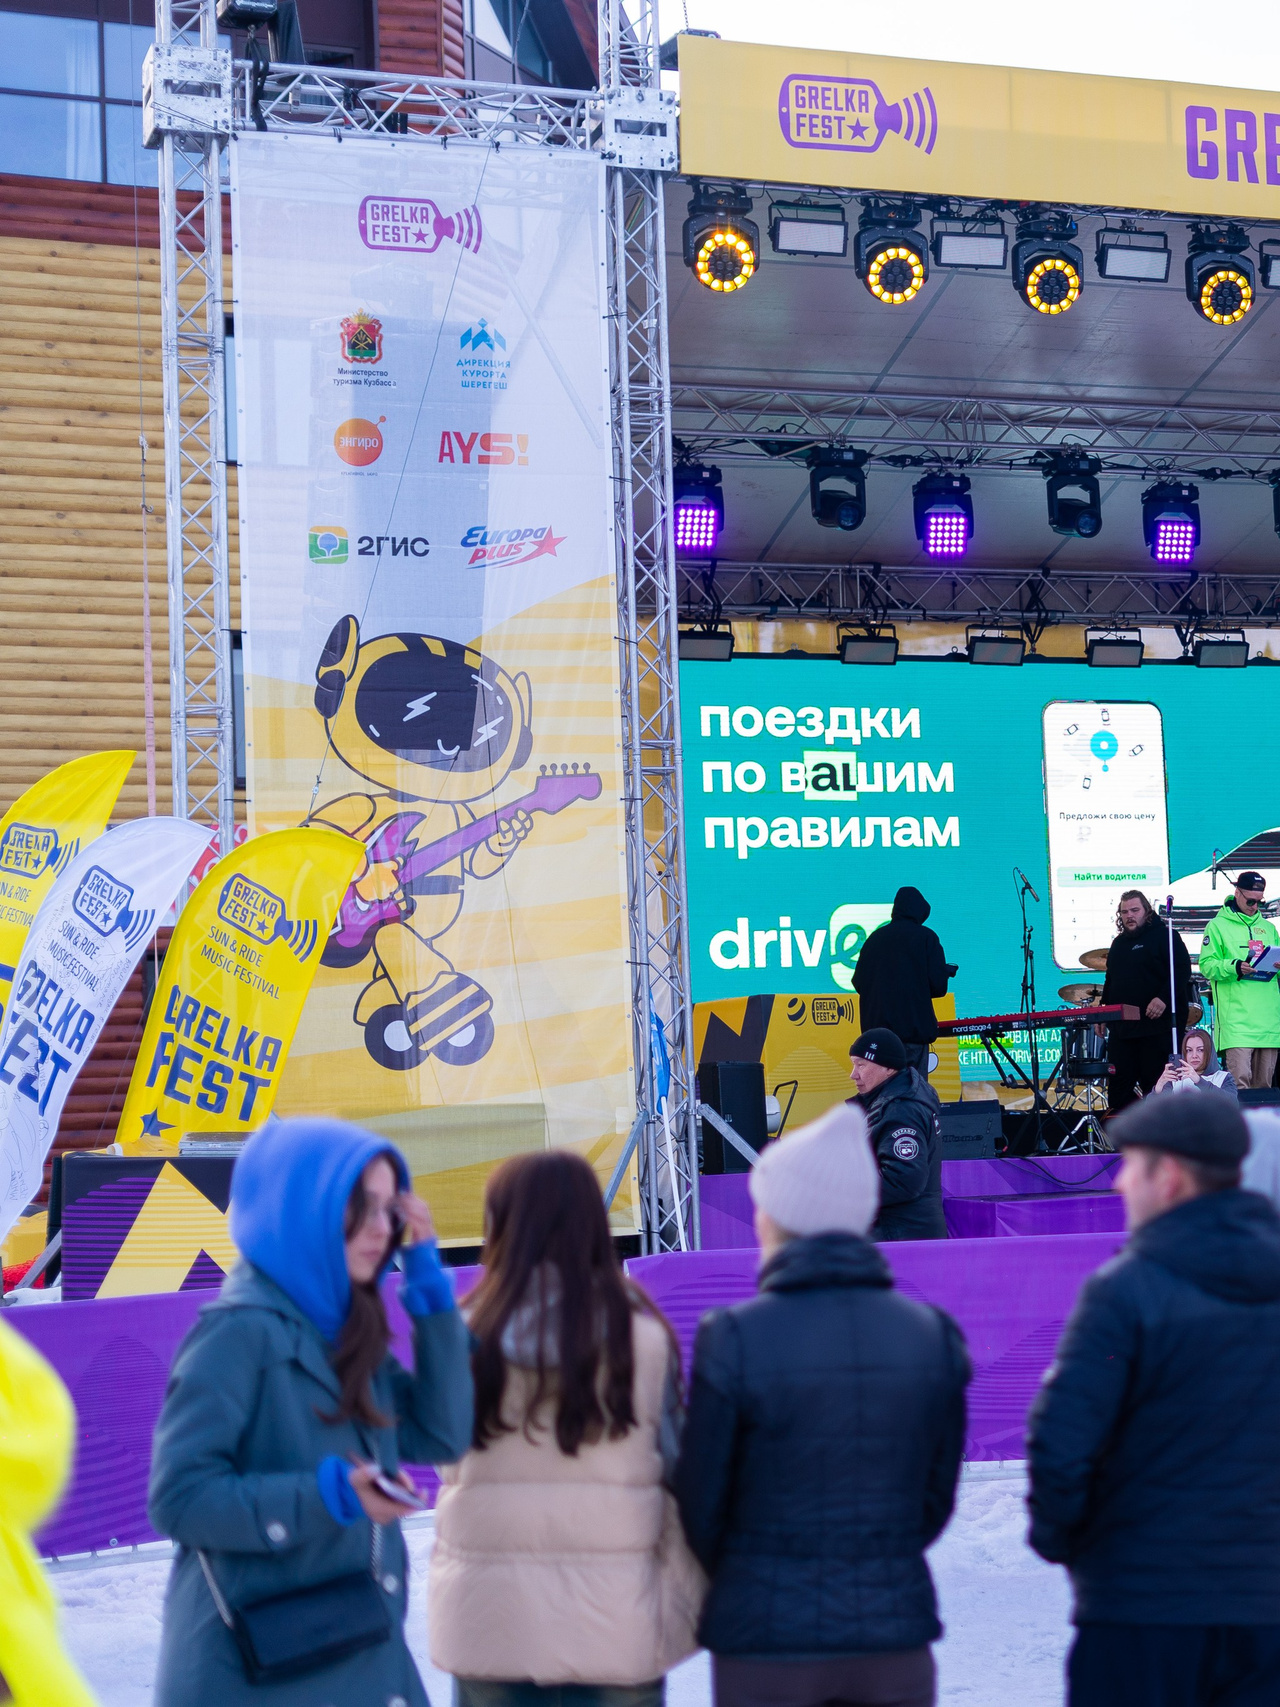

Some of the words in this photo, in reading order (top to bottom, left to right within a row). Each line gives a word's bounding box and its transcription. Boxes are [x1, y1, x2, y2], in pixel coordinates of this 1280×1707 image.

[794, 85, 869, 114] GRELKA
[796, 113, 846, 140] FEST
[370, 203, 430, 225] GRELKA
[371, 224, 411, 243] FEST
[337, 367, 389, 378] Министерство
[456, 359, 511, 369] ДИРЕКЦИЯ
[462, 369, 506, 379] КУРОРТА
[333, 378, 362, 387] туризма
[363, 378, 397, 387] Кузбасса
[461, 380, 508, 390] ШЕРЕГЕШ
[339, 436, 379, 450] энгиро
[438, 431, 529, 466] AYS!
[357, 535, 430, 557] 2ГИС
[700, 705, 921, 745] поездки
[702, 760, 766, 793] по
[781, 760, 955, 793] вашим
[1059, 812, 1107, 821] Предложи
[1134, 813, 1156, 821] цену
[704, 816, 961, 860] правилам
[1074, 872, 1102, 881] Найти
[1104, 873, 1147, 881] водителя
[14, 886, 31, 903] RIDE
[87, 873, 127, 910] GRELKA
[233, 880, 278, 918] GRELKA
[80, 891, 108, 920] FEST
[224, 899, 258, 928] FEST
[7, 908, 34, 928] FESTIVA
[58, 921, 77, 941] SUN
[73, 933, 81, 947] &
[79, 936, 100, 960] RIDE
[208, 925, 230, 947] SUN
[229, 940, 238, 953] &
[238, 944, 264, 968] RIDE
[708, 916, 891, 969] drive
[47, 939, 72, 967] MUSIC
[66, 957, 99, 992] FESTIVAL
[200, 944, 232, 975] MUSIC
[232, 962, 280, 1000] FESTIVAL
[815, 1001, 836, 1011] GRELKA
[816, 1012, 830, 1021] FEST
[952, 1025, 968, 1033] nord
[969, 1024, 986, 1033] stage
